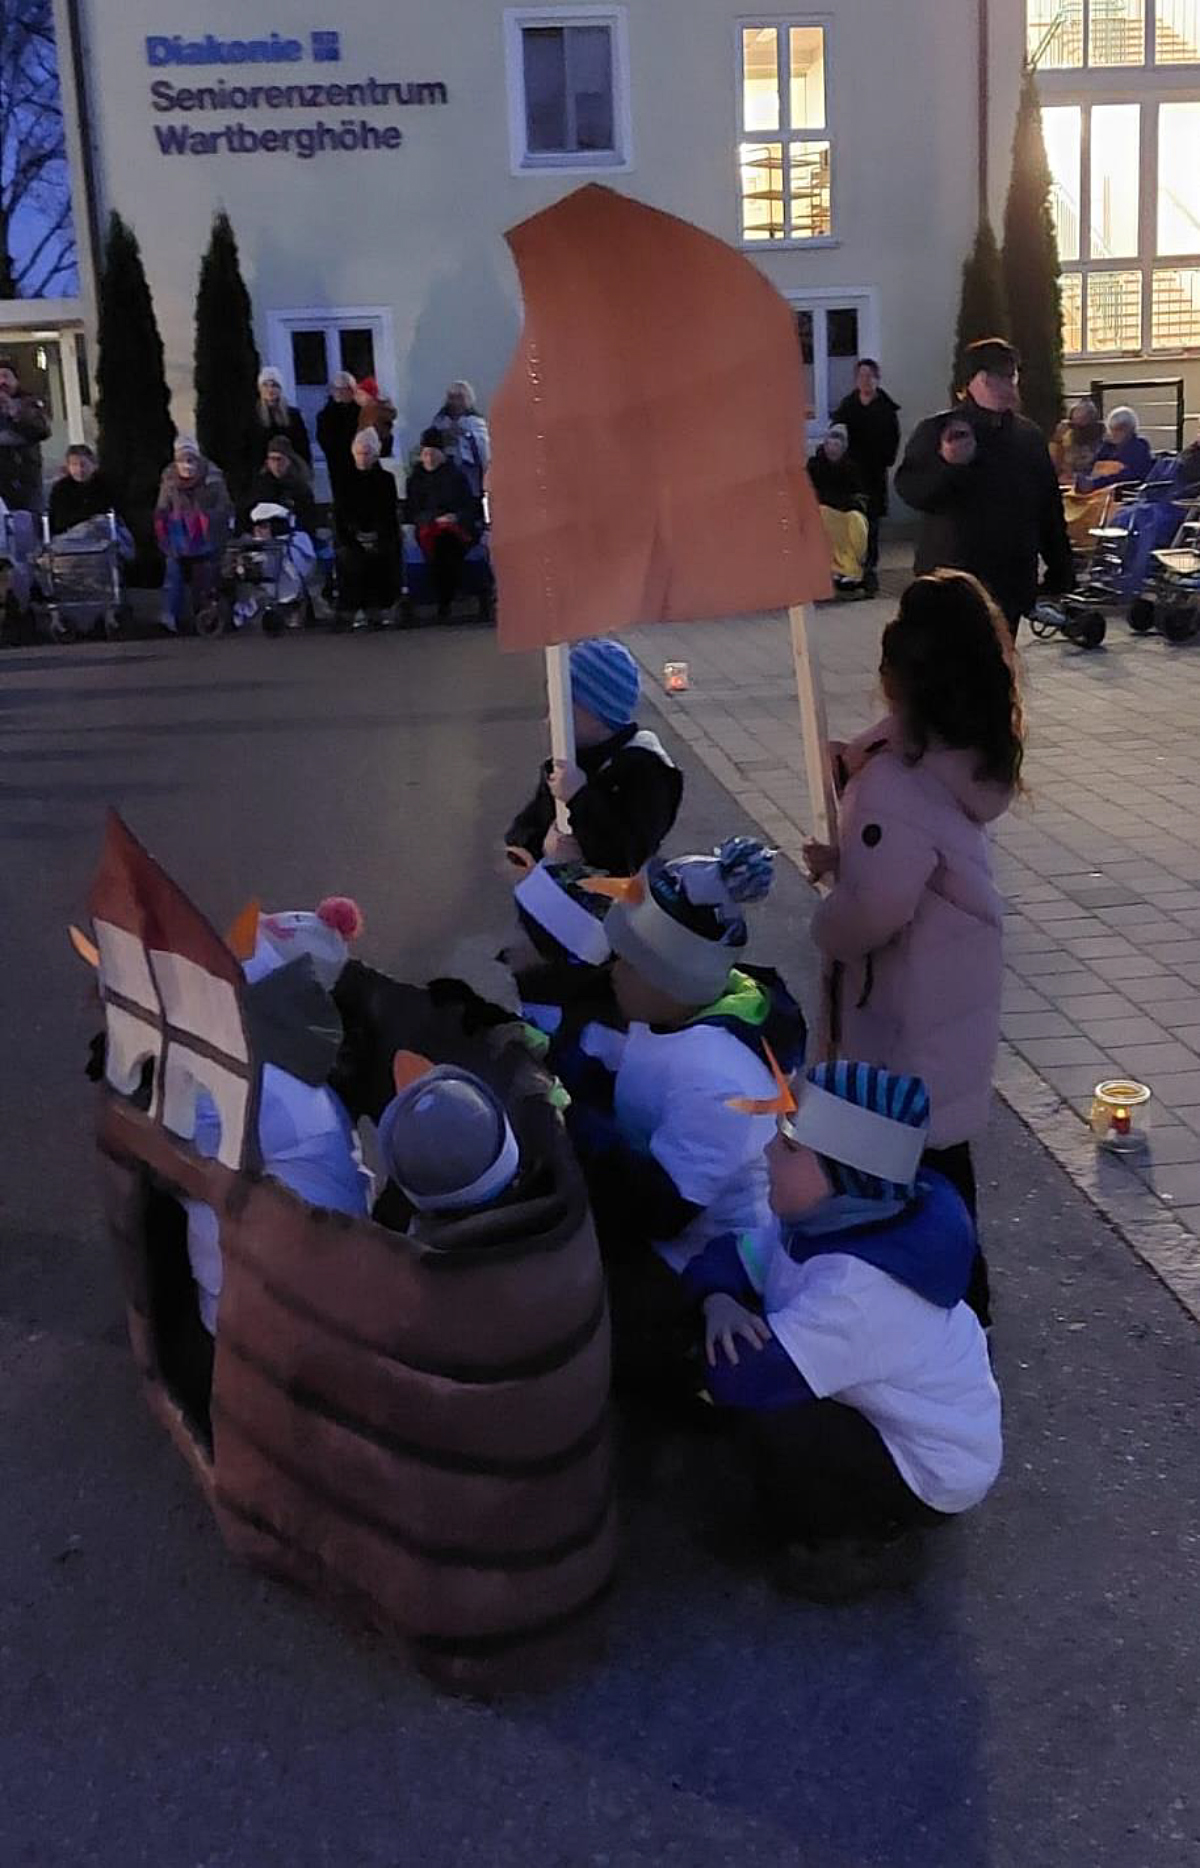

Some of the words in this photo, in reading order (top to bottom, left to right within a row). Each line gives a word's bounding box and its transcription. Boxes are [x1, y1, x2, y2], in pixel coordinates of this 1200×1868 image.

[146, 32, 303, 66] Diakonie
[150, 77, 449, 112] Seniorenzentrum
[154, 120, 403, 159] Wartberghöhe
